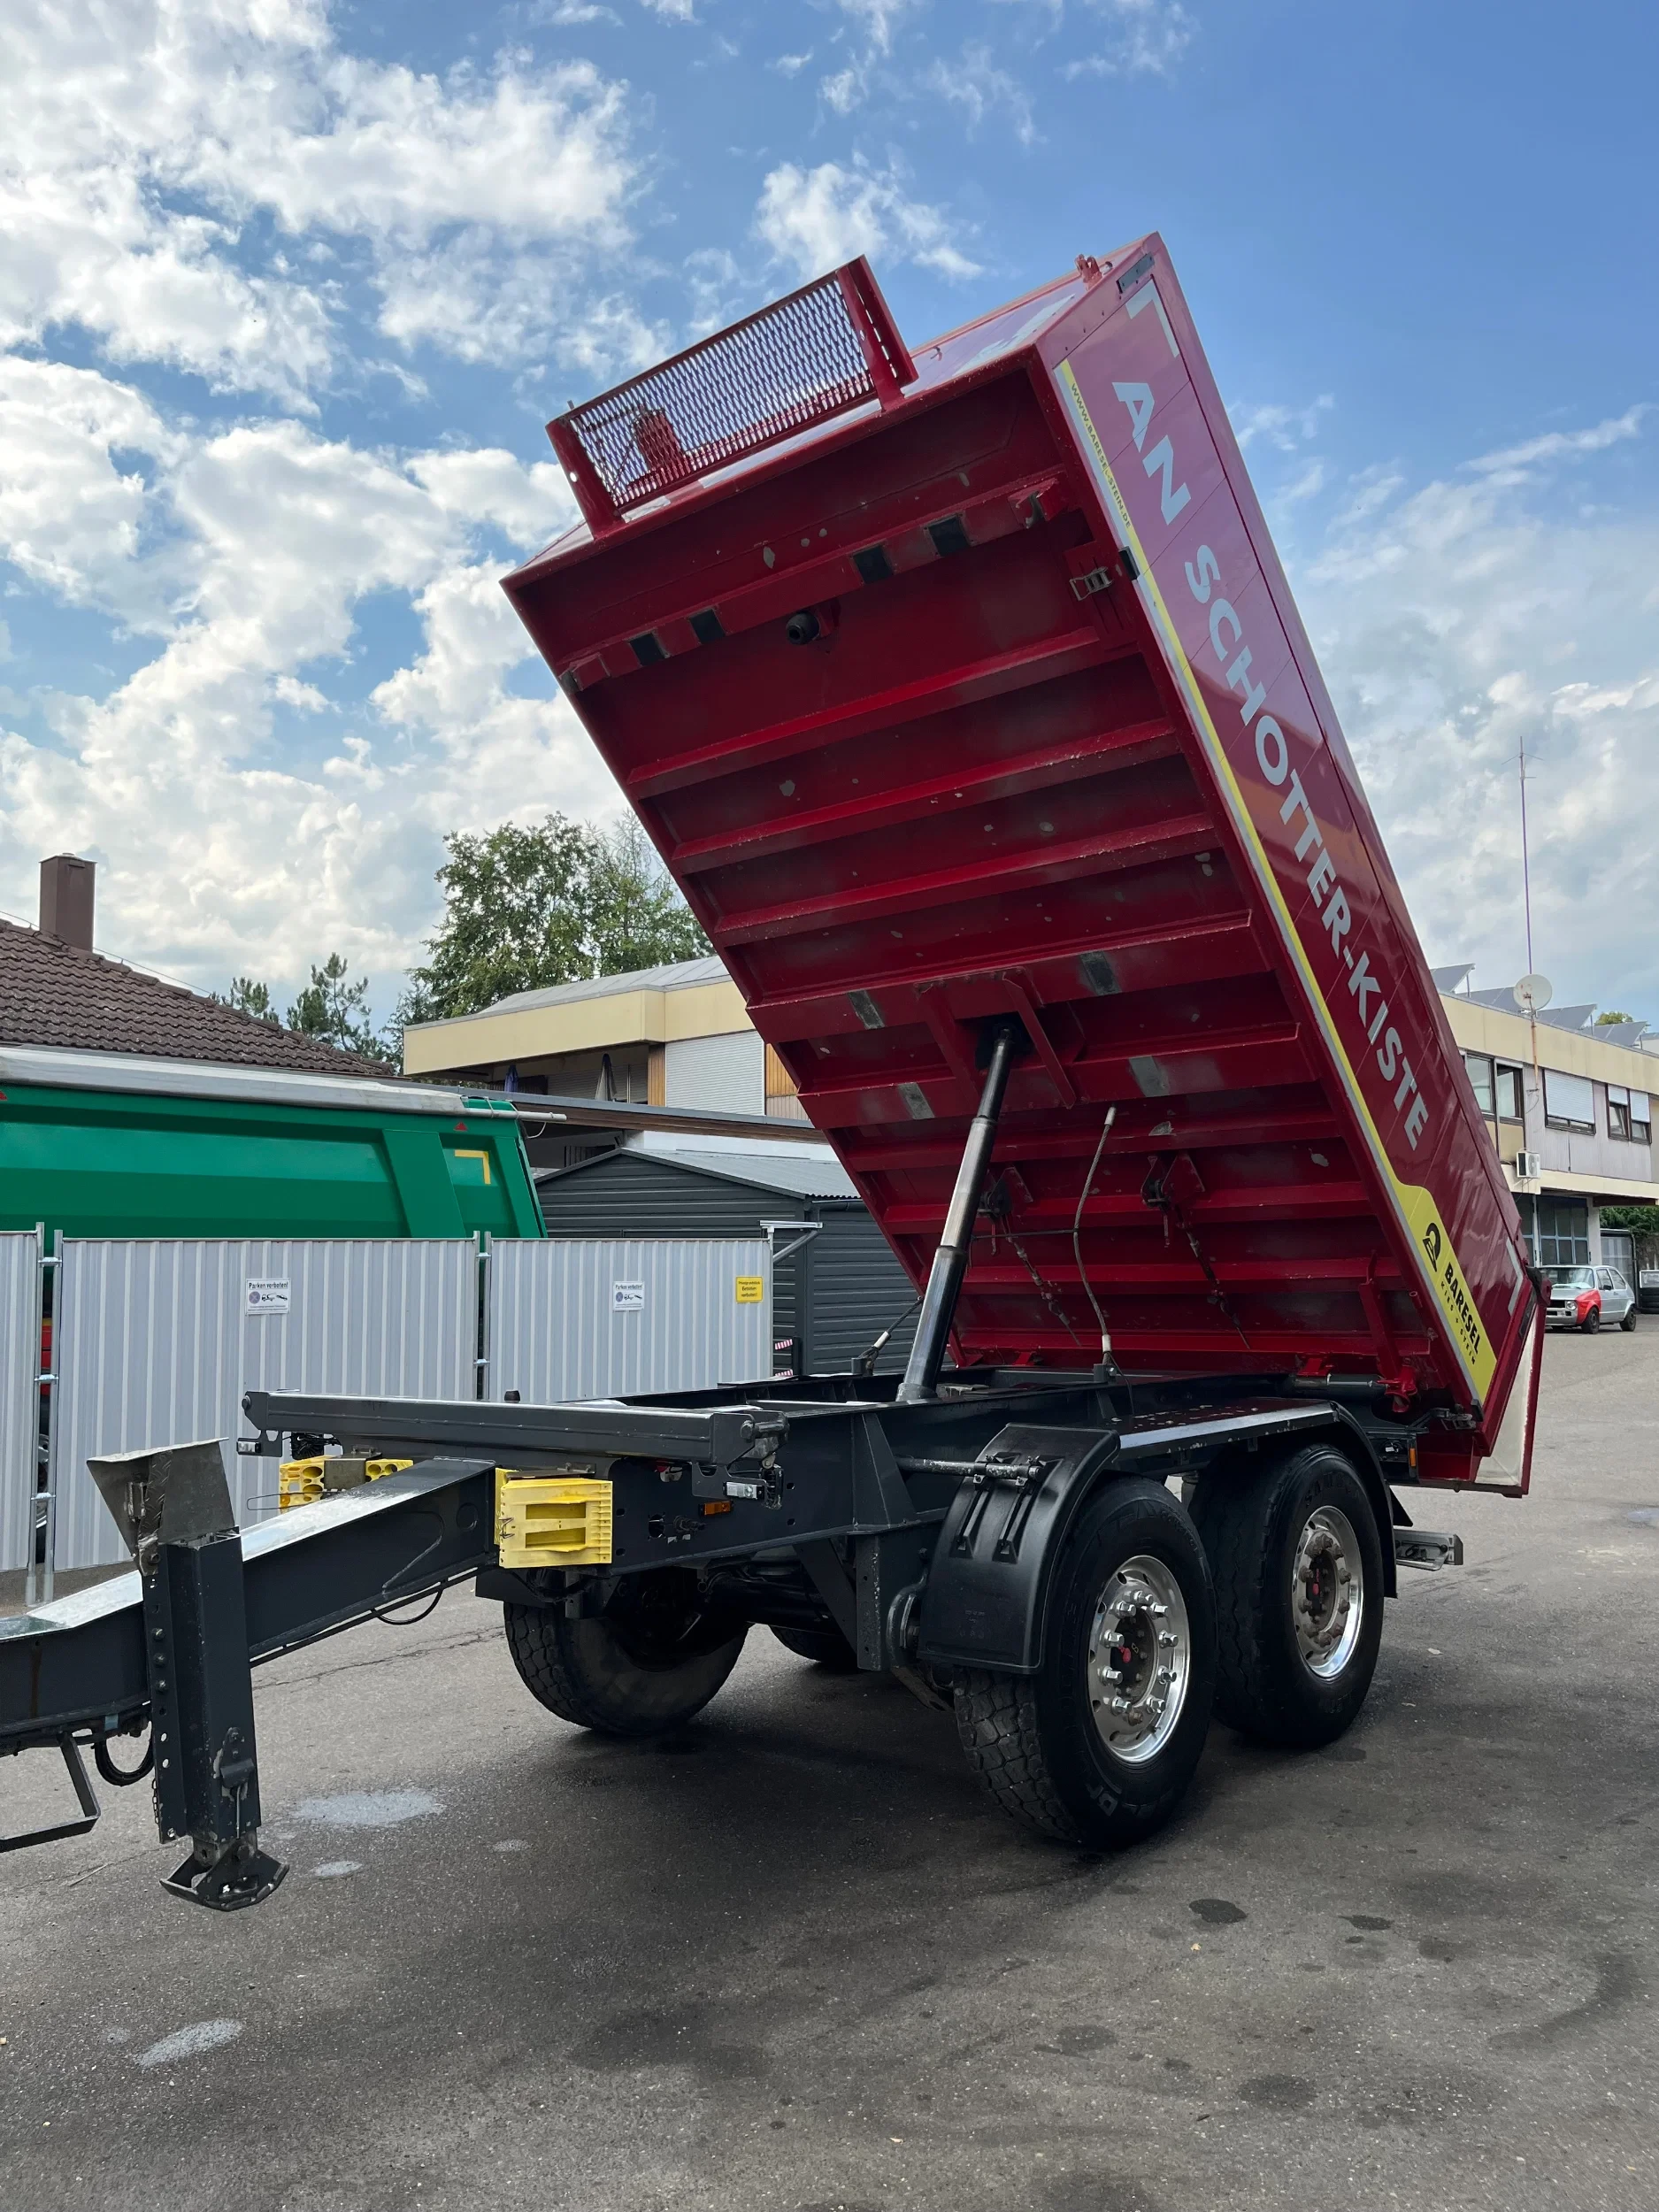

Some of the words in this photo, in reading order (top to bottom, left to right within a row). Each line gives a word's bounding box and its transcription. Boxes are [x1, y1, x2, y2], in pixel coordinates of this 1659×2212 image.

[1111, 381, 1192, 526] AN
[1185, 544, 1429, 1151] SCHOTTER-KISTE
[1445, 1262, 1480, 1355] BARESEL
